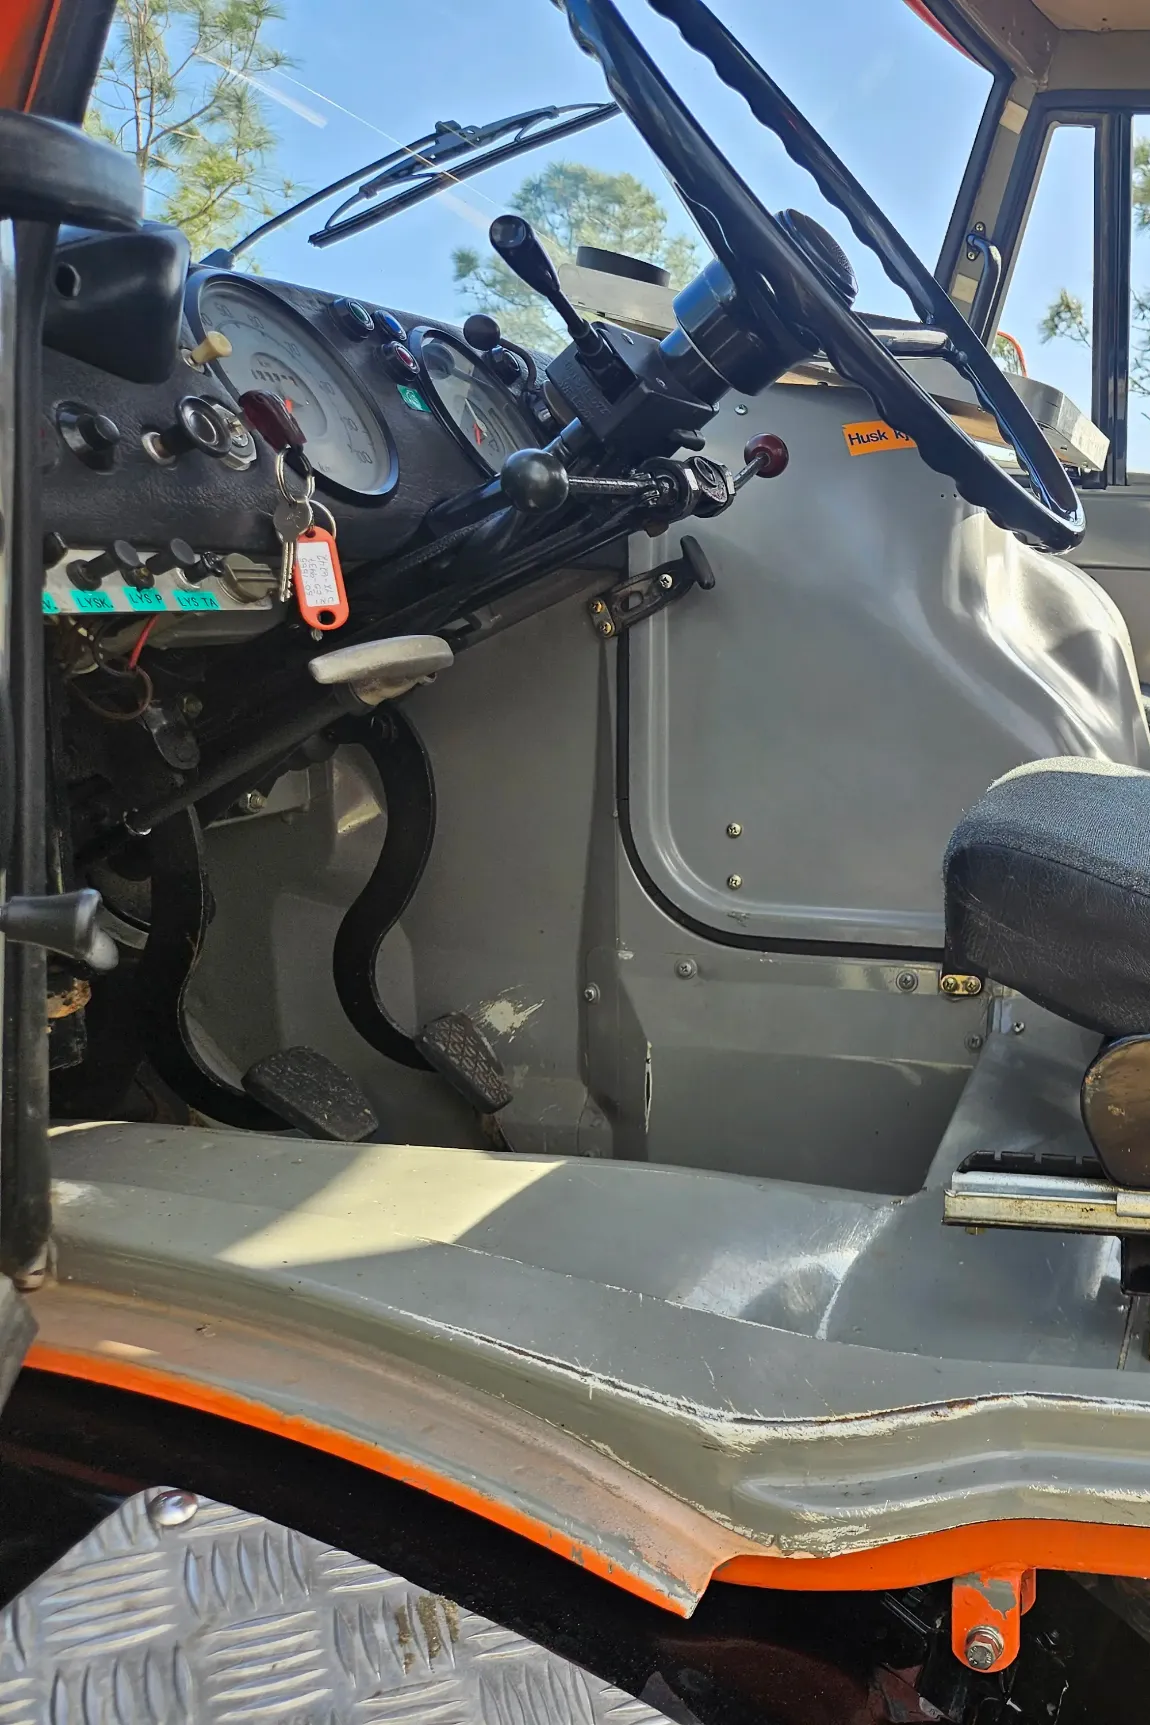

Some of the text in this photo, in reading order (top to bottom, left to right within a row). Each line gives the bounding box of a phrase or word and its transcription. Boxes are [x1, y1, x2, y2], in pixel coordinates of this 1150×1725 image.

[848, 429, 889, 446] Husk
[129, 593, 152, 604] LYS
[177, 596, 219, 608] LYS TA
